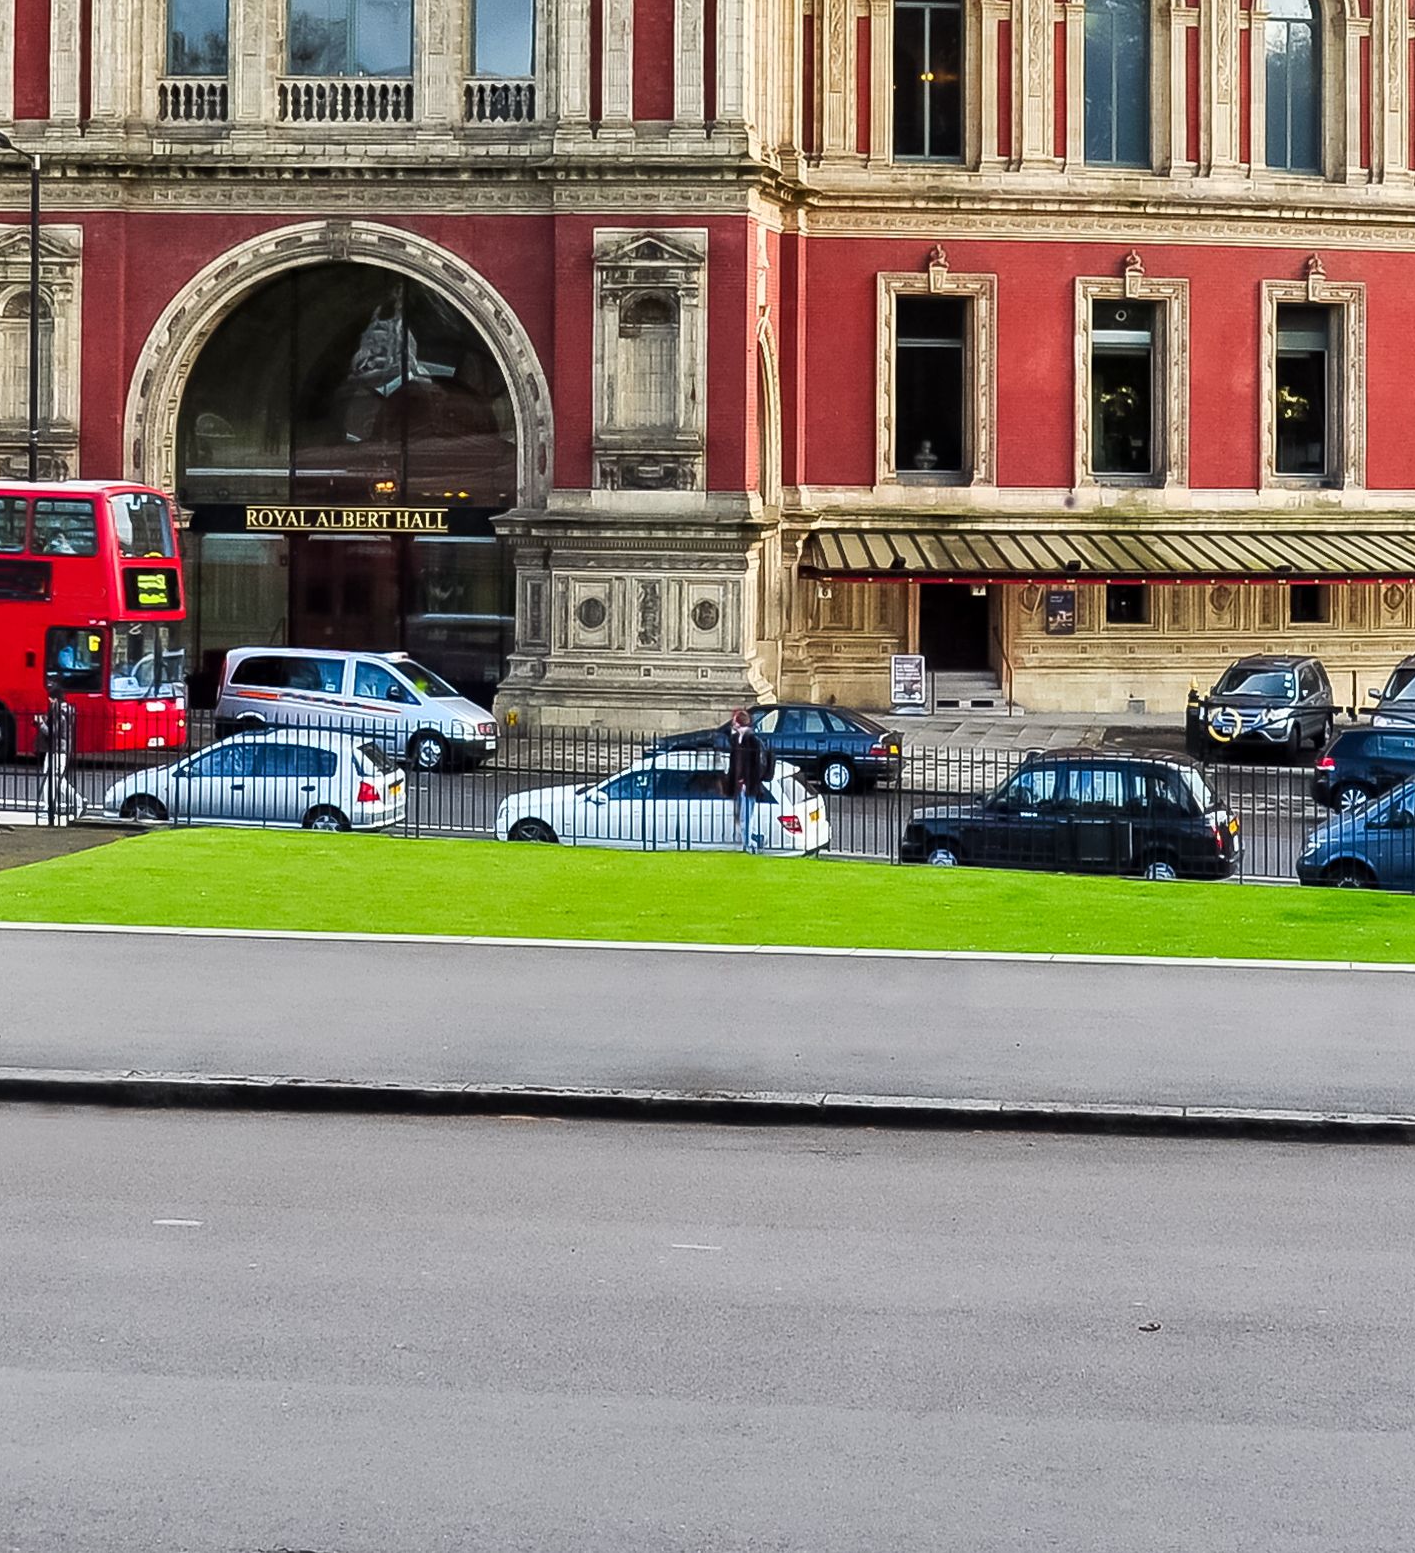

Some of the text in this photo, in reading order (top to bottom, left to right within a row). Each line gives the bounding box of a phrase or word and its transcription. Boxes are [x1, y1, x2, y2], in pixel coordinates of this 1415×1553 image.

[246, 509, 449, 529] ROYAL ALBERT HALL
